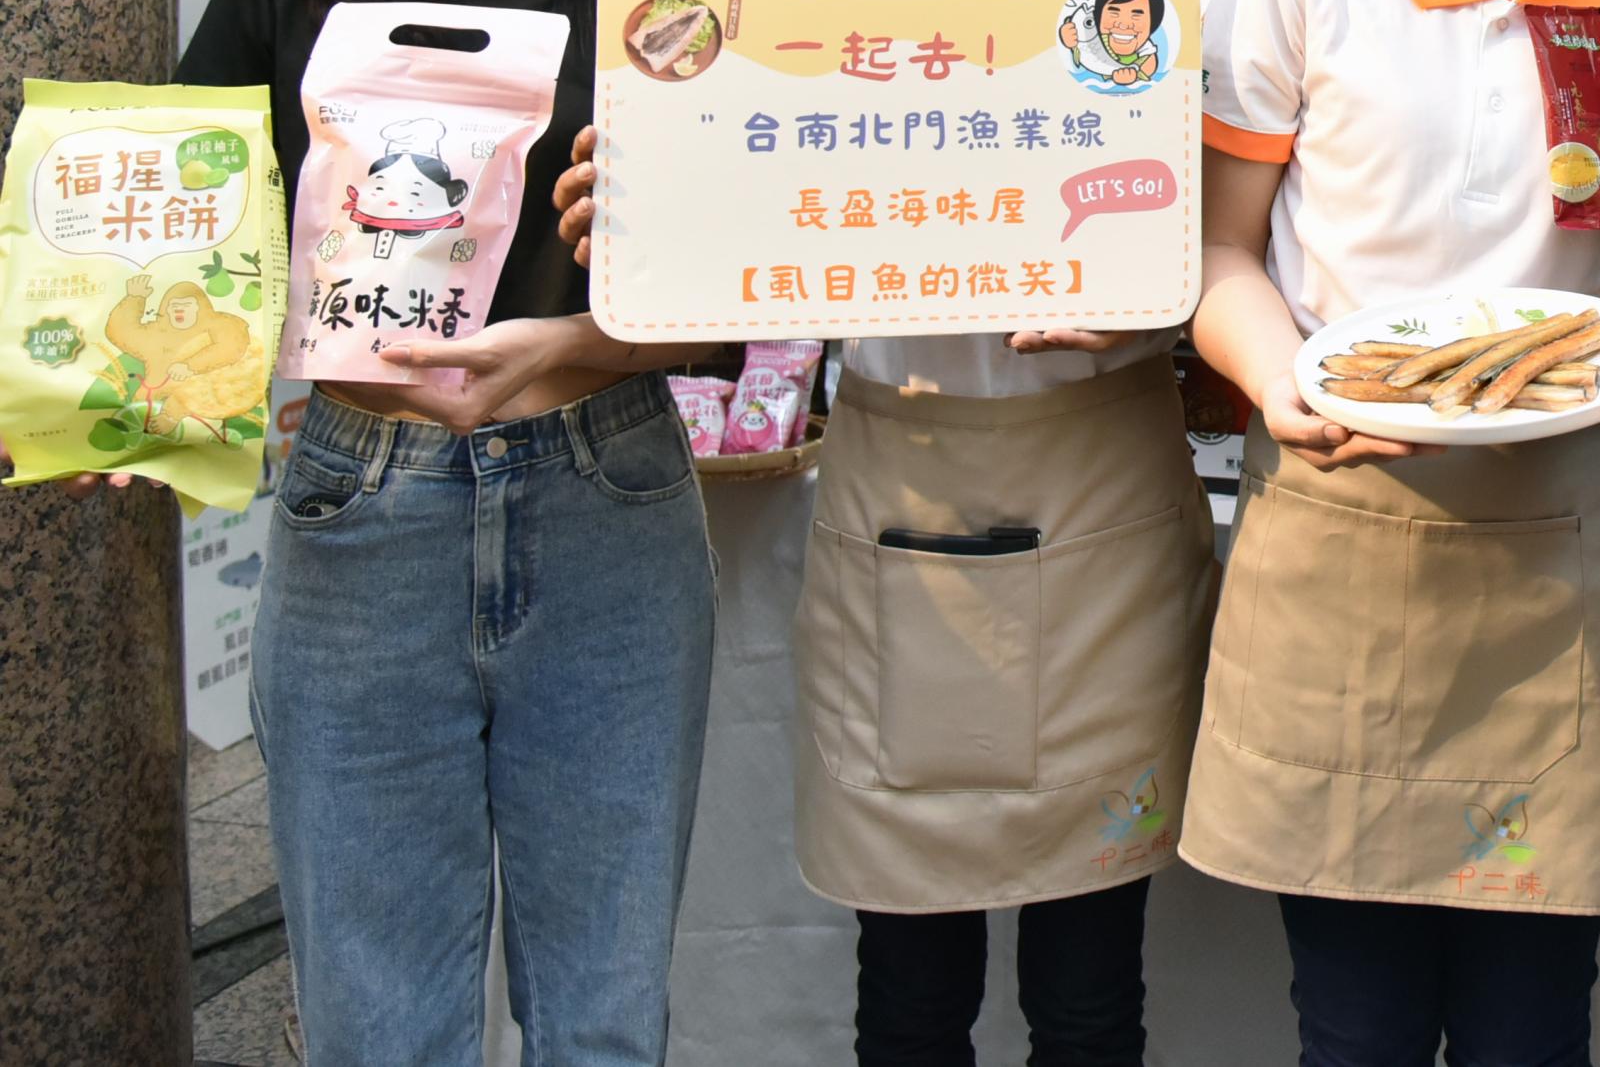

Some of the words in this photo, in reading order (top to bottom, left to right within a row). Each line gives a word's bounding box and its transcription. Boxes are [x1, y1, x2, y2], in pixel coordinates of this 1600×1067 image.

[775, 31, 995, 83] 一起去!
[186, 138, 239, 154] 檸檬柚子
[222, 155, 240, 164] 風味
[55, 150, 164, 200] 福猩
[1078, 177, 1125, 203] LET'S
[1132, 176, 1165, 199] GO!
[102, 194, 219, 243] 米餅
[789, 187, 1027, 230] 長盈海味屋
[741, 260, 1084, 303] 【虱目魚的微笑】
[320, 278, 471, 339] 原味米香
[33, 329, 74, 344] 100%
[34, 344, 68, 355] 非油炸
[1448, 865, 1548, 900] 十二味
